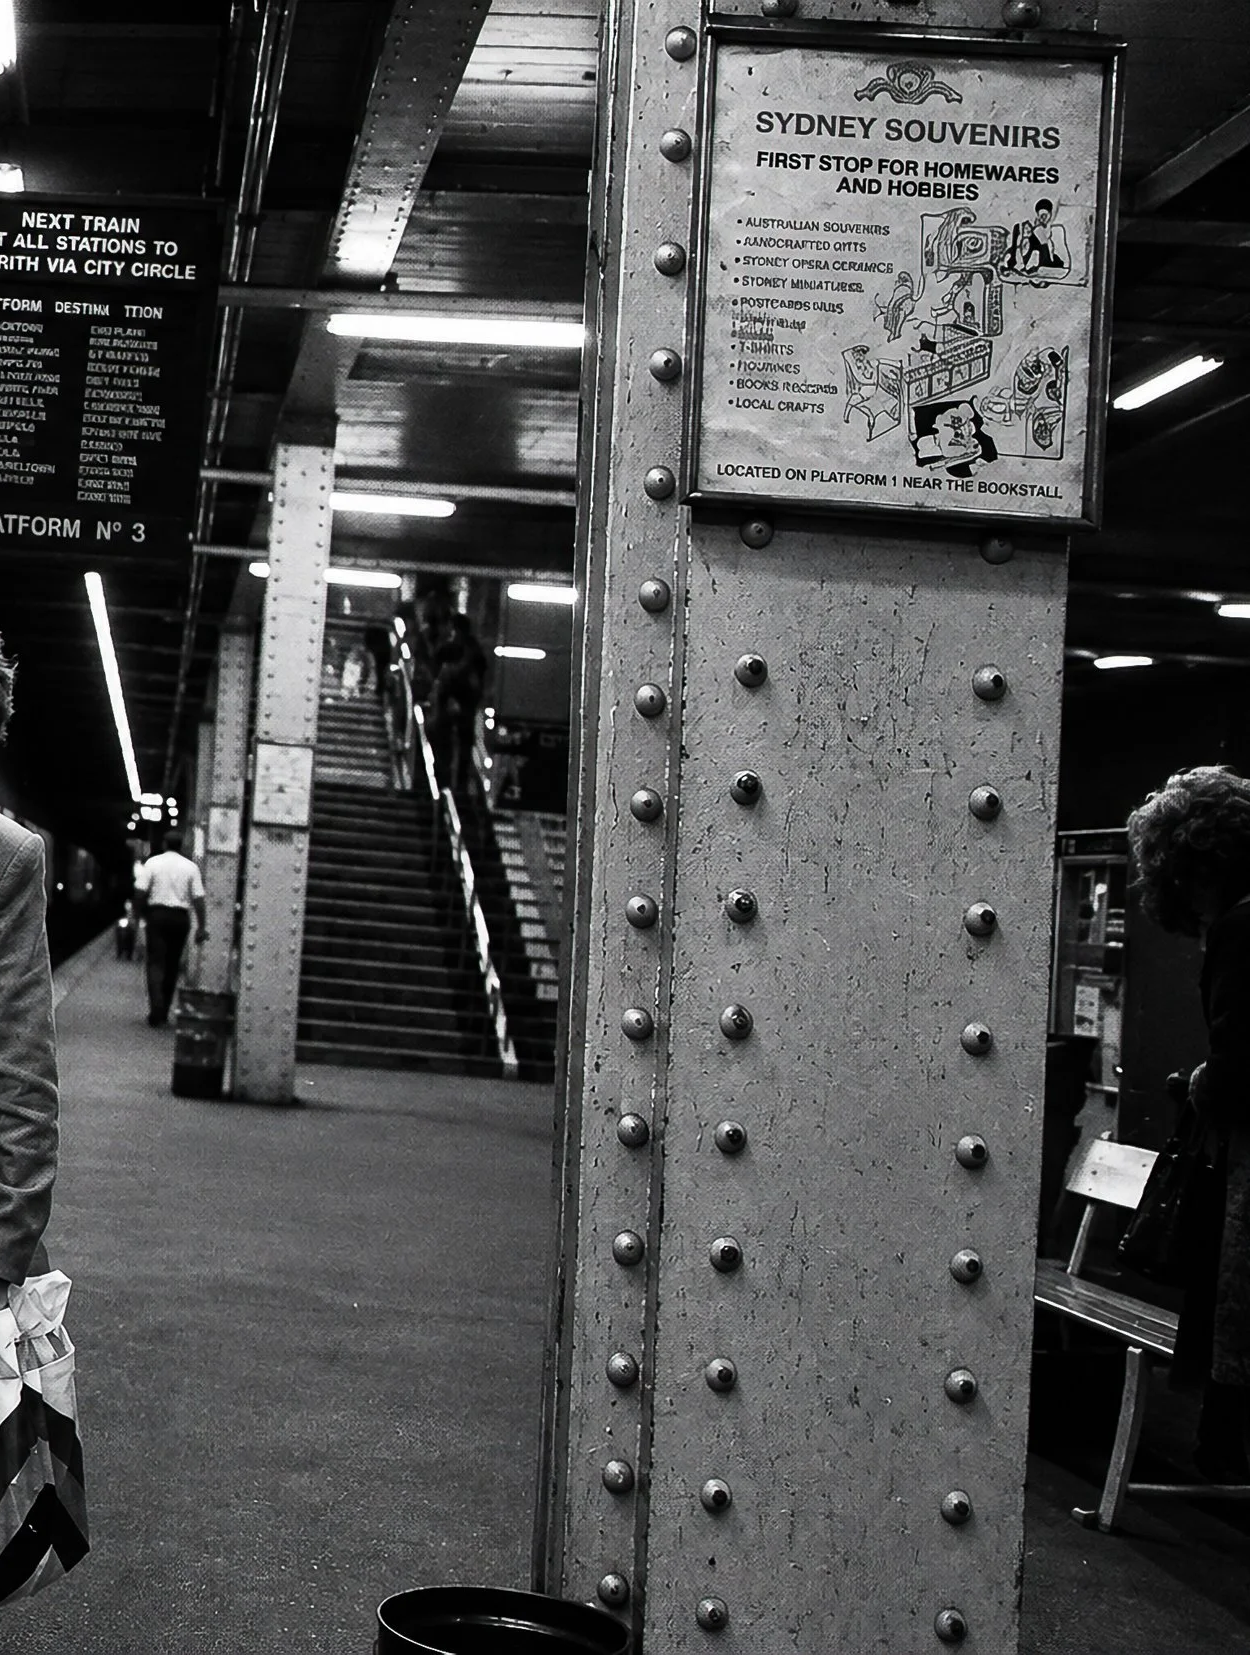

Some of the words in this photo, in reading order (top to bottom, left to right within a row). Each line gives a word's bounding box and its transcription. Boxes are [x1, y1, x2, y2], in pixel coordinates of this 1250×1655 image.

[756, 111, 878, 140] SYDNEY
[884, 118, 1062, 150] SOUVENIRS
[756, 151, 816, 171] FIRST
[819, 154, 874, 174] STOP
[877, 158, 919, 177] FOR
[924, 161, 1060, 184] HOMEWARES
[836, 177, 882, 195] AND
[887, 178, 980, 202] HOBBIES
[21, 211, 75, 230] NEXT
[81, 215, 141, 234] TRAIN
[12, 233, 49, 249] ALL
[56, 235, 146, 255] STATIONS
[153, 240, 179, 256] TO
[47, 257, 78, 274] VIA
[83, 259, 126, 276] CITY
[130, 262, 197, 280] CIRCLE
[716, 463, 781, 480] LOCATED
[785, 468, 807, 481] ON
[811, 470, 887, 486] PLATFORM
[891, 475, 897, 487] 1
[902, 476, 942, 491] NEAR
[946, 478, 974, 493] THE
[978, 480, 1063, 499] BOOKSTALL
[131, 522, 146, 543] 3
